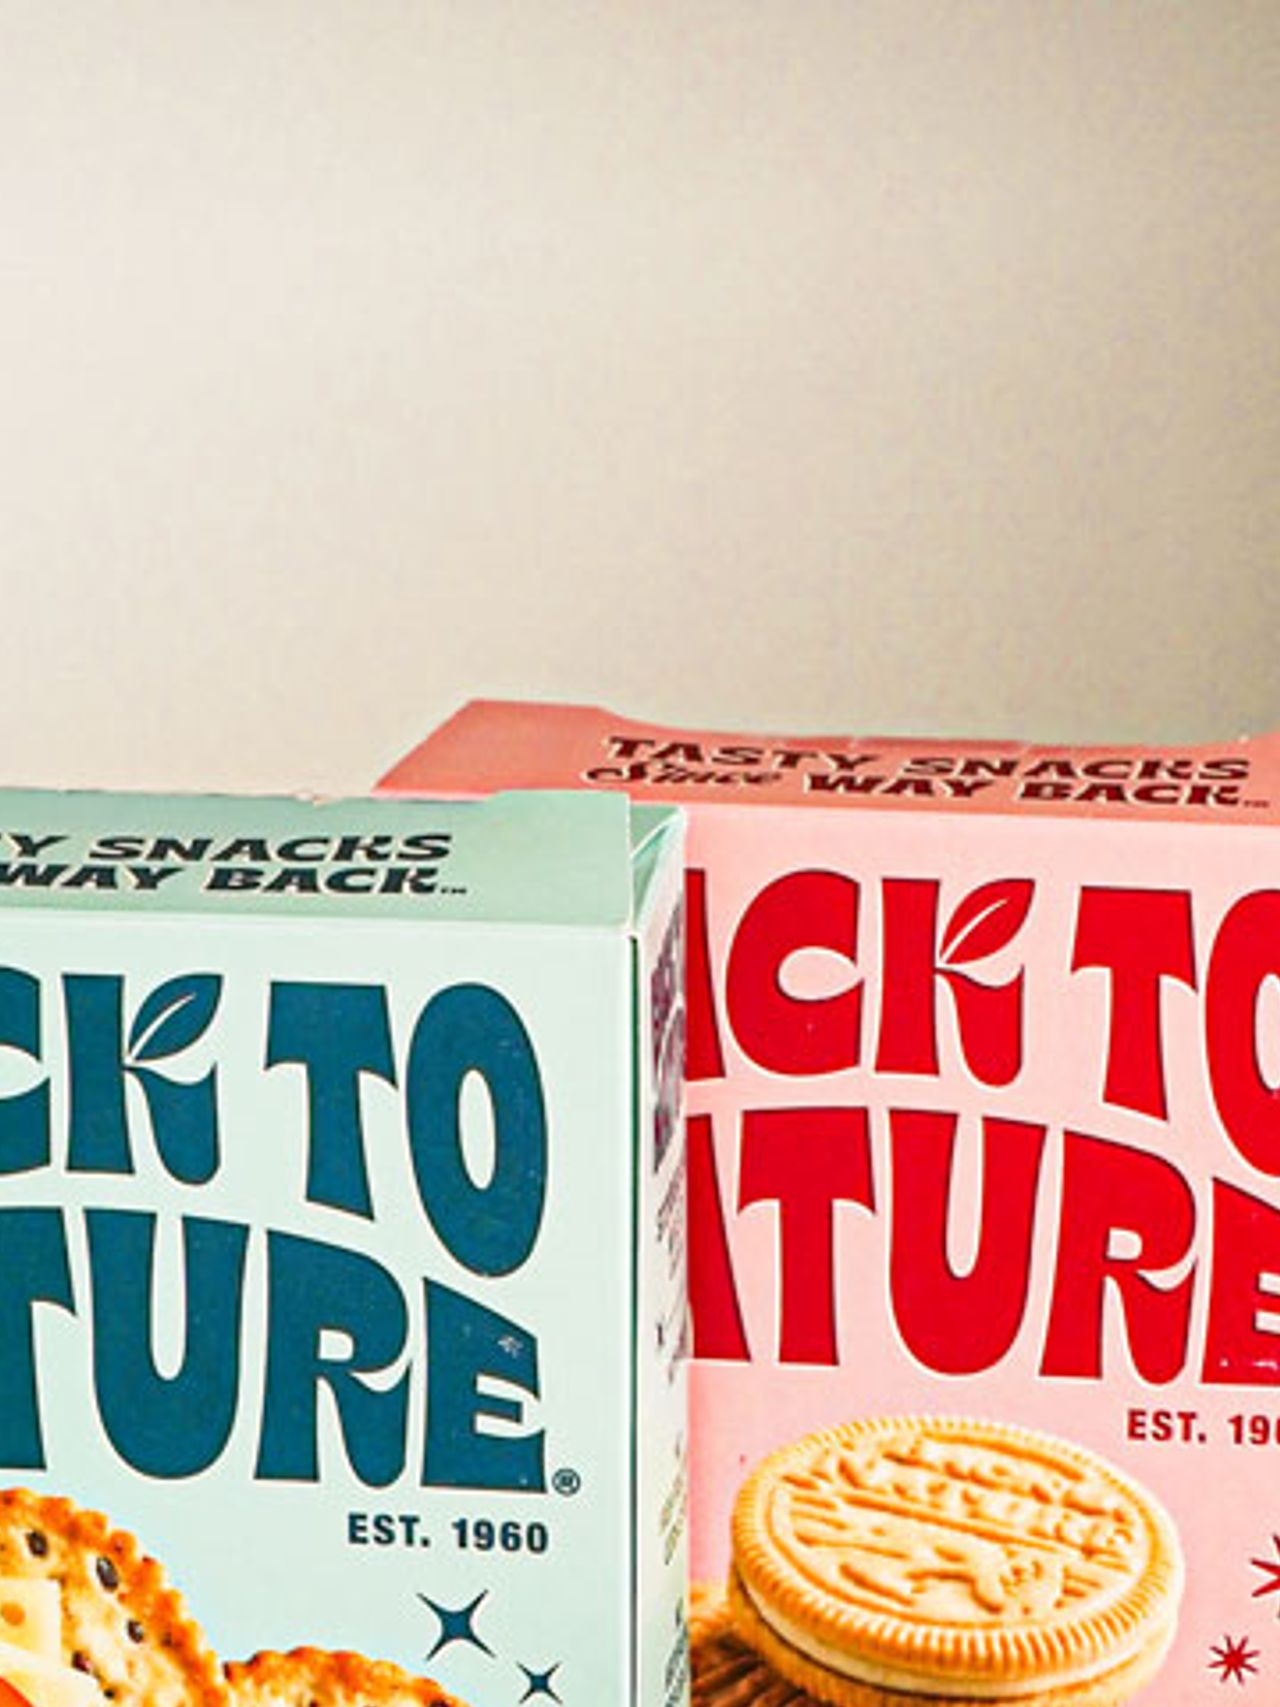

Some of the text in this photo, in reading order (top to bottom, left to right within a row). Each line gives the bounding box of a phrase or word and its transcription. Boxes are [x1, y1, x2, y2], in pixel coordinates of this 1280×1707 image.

[584, 759, 783, 787] Since
[807, 773, 992, 799] WAY
[605, 735, 1251, 784] TASTY SNACKS
[86, 833, 453, 864] SNACKS
[686, 868, 1034, 1089] CK
[264, 980, 549, 1278] TO
[1126, 1410, 1206, 1445] EST.
[346, 1513, 549, 1555] EST. 1960
